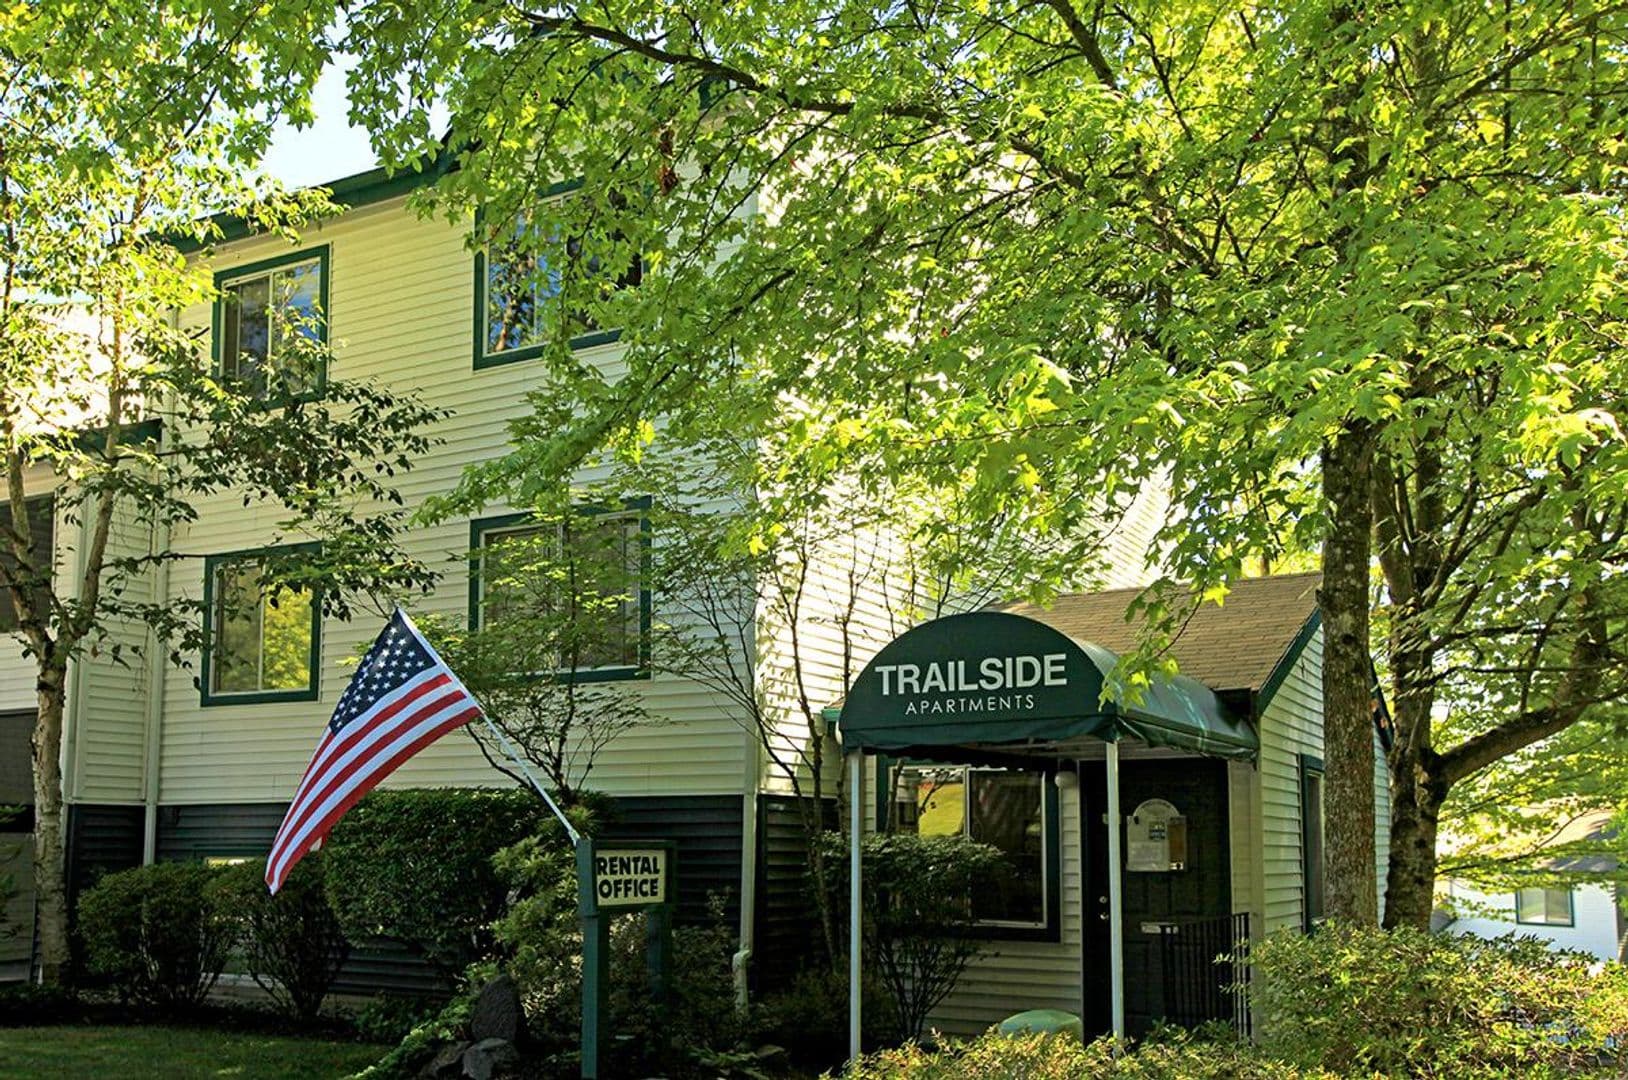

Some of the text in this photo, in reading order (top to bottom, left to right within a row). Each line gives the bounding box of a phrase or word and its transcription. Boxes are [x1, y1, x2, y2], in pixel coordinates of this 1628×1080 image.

[875, 653, 1068, 696] TRAILSIDE
[905, 694, 1035, 715] APARTMENTS
[596, 856, 660, 875] RENTAL
[598, 878, 659, 898] OFFICE
